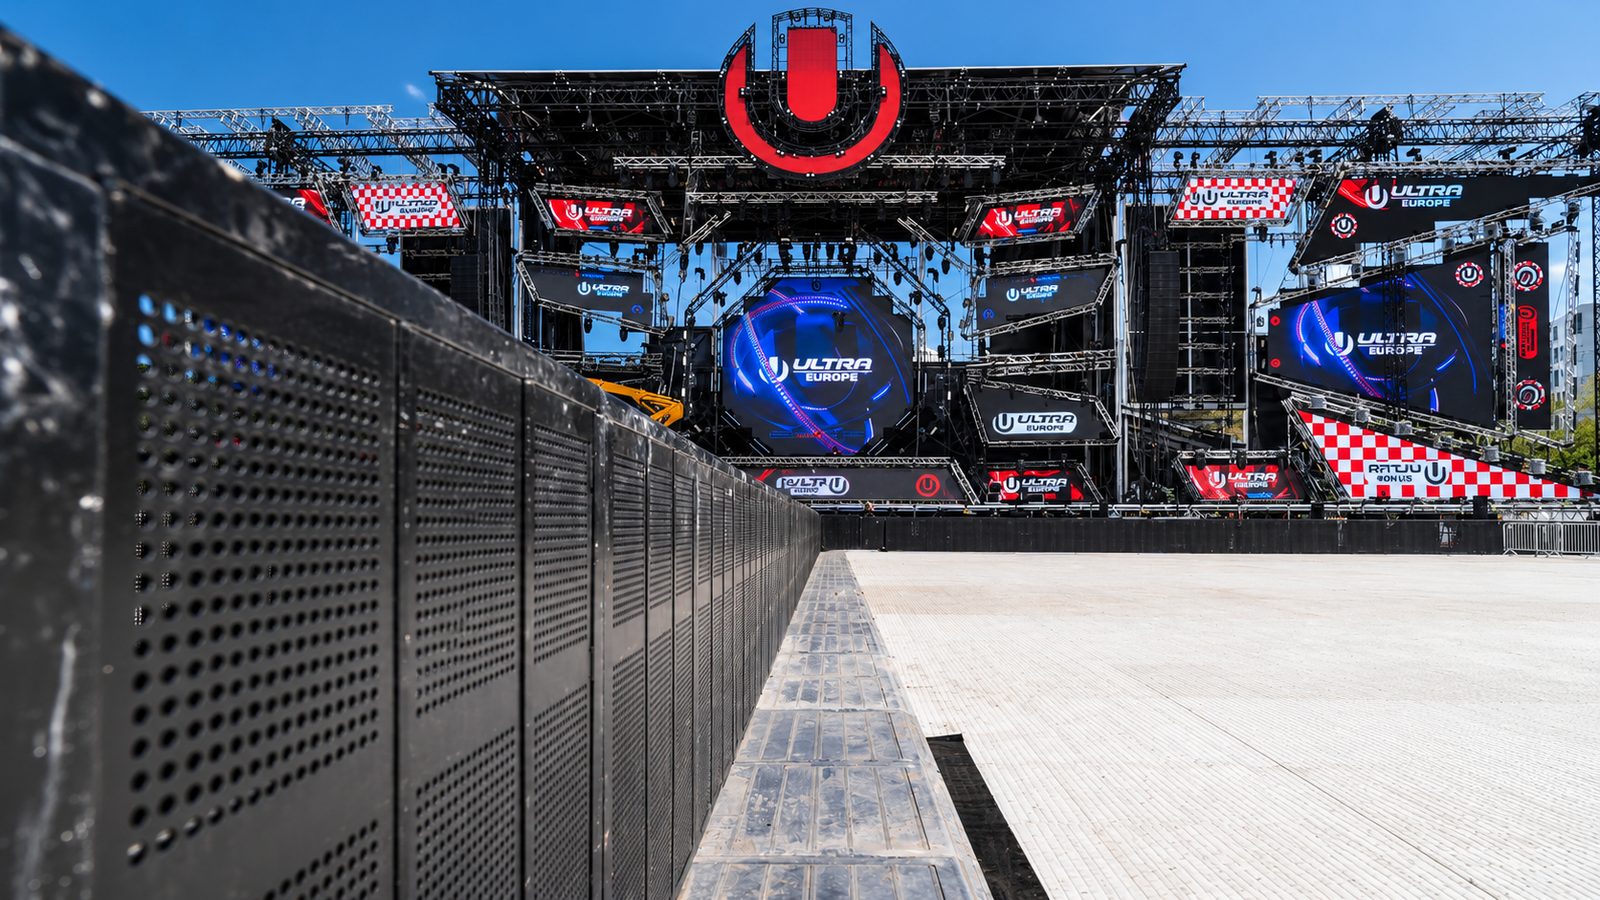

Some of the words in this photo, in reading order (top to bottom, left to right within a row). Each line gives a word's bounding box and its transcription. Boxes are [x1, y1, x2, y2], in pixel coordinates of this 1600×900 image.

[1391, 185, 1463, 197] ULTRA
[1402, 199, 1451, 207] EUROPE
[585, 206, 633, 217] ULTRA
[1014, 207, 1062, 219] ULTRA
[1357, 333, 1437, 343] ULTRA
[1369, 346, 1423, 354] EUROPE
[793, 358, 872, 370] ULTRA
[806, 373, 858, 382] EUROPE
[1018, 414, 1075, 423] ULTRA
[1228, 472, 1277, 482] ULTRA
[1022, 478, 1067, 487] ULTRA
